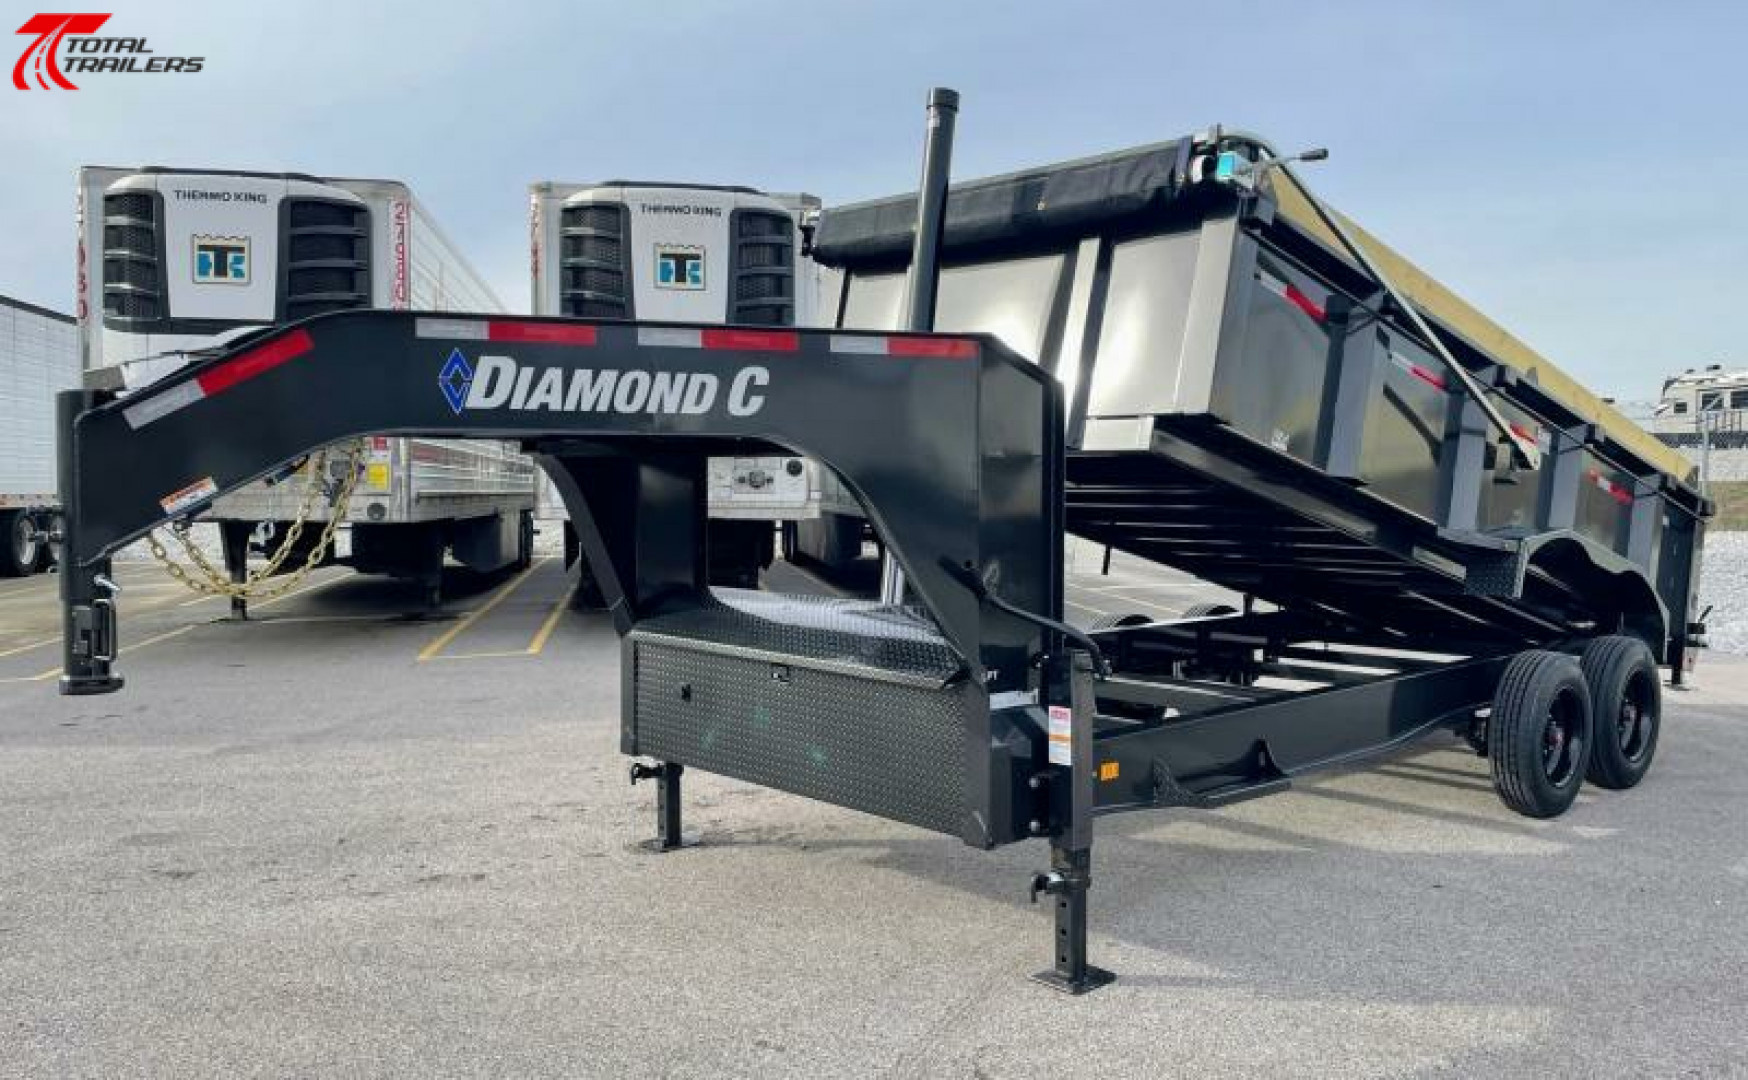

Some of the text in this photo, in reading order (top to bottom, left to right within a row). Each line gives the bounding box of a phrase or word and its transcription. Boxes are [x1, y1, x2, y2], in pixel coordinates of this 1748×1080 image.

[174, 189, 268, 204] THERMO KING
[465, 355, 770, 417] DIAMOND C
